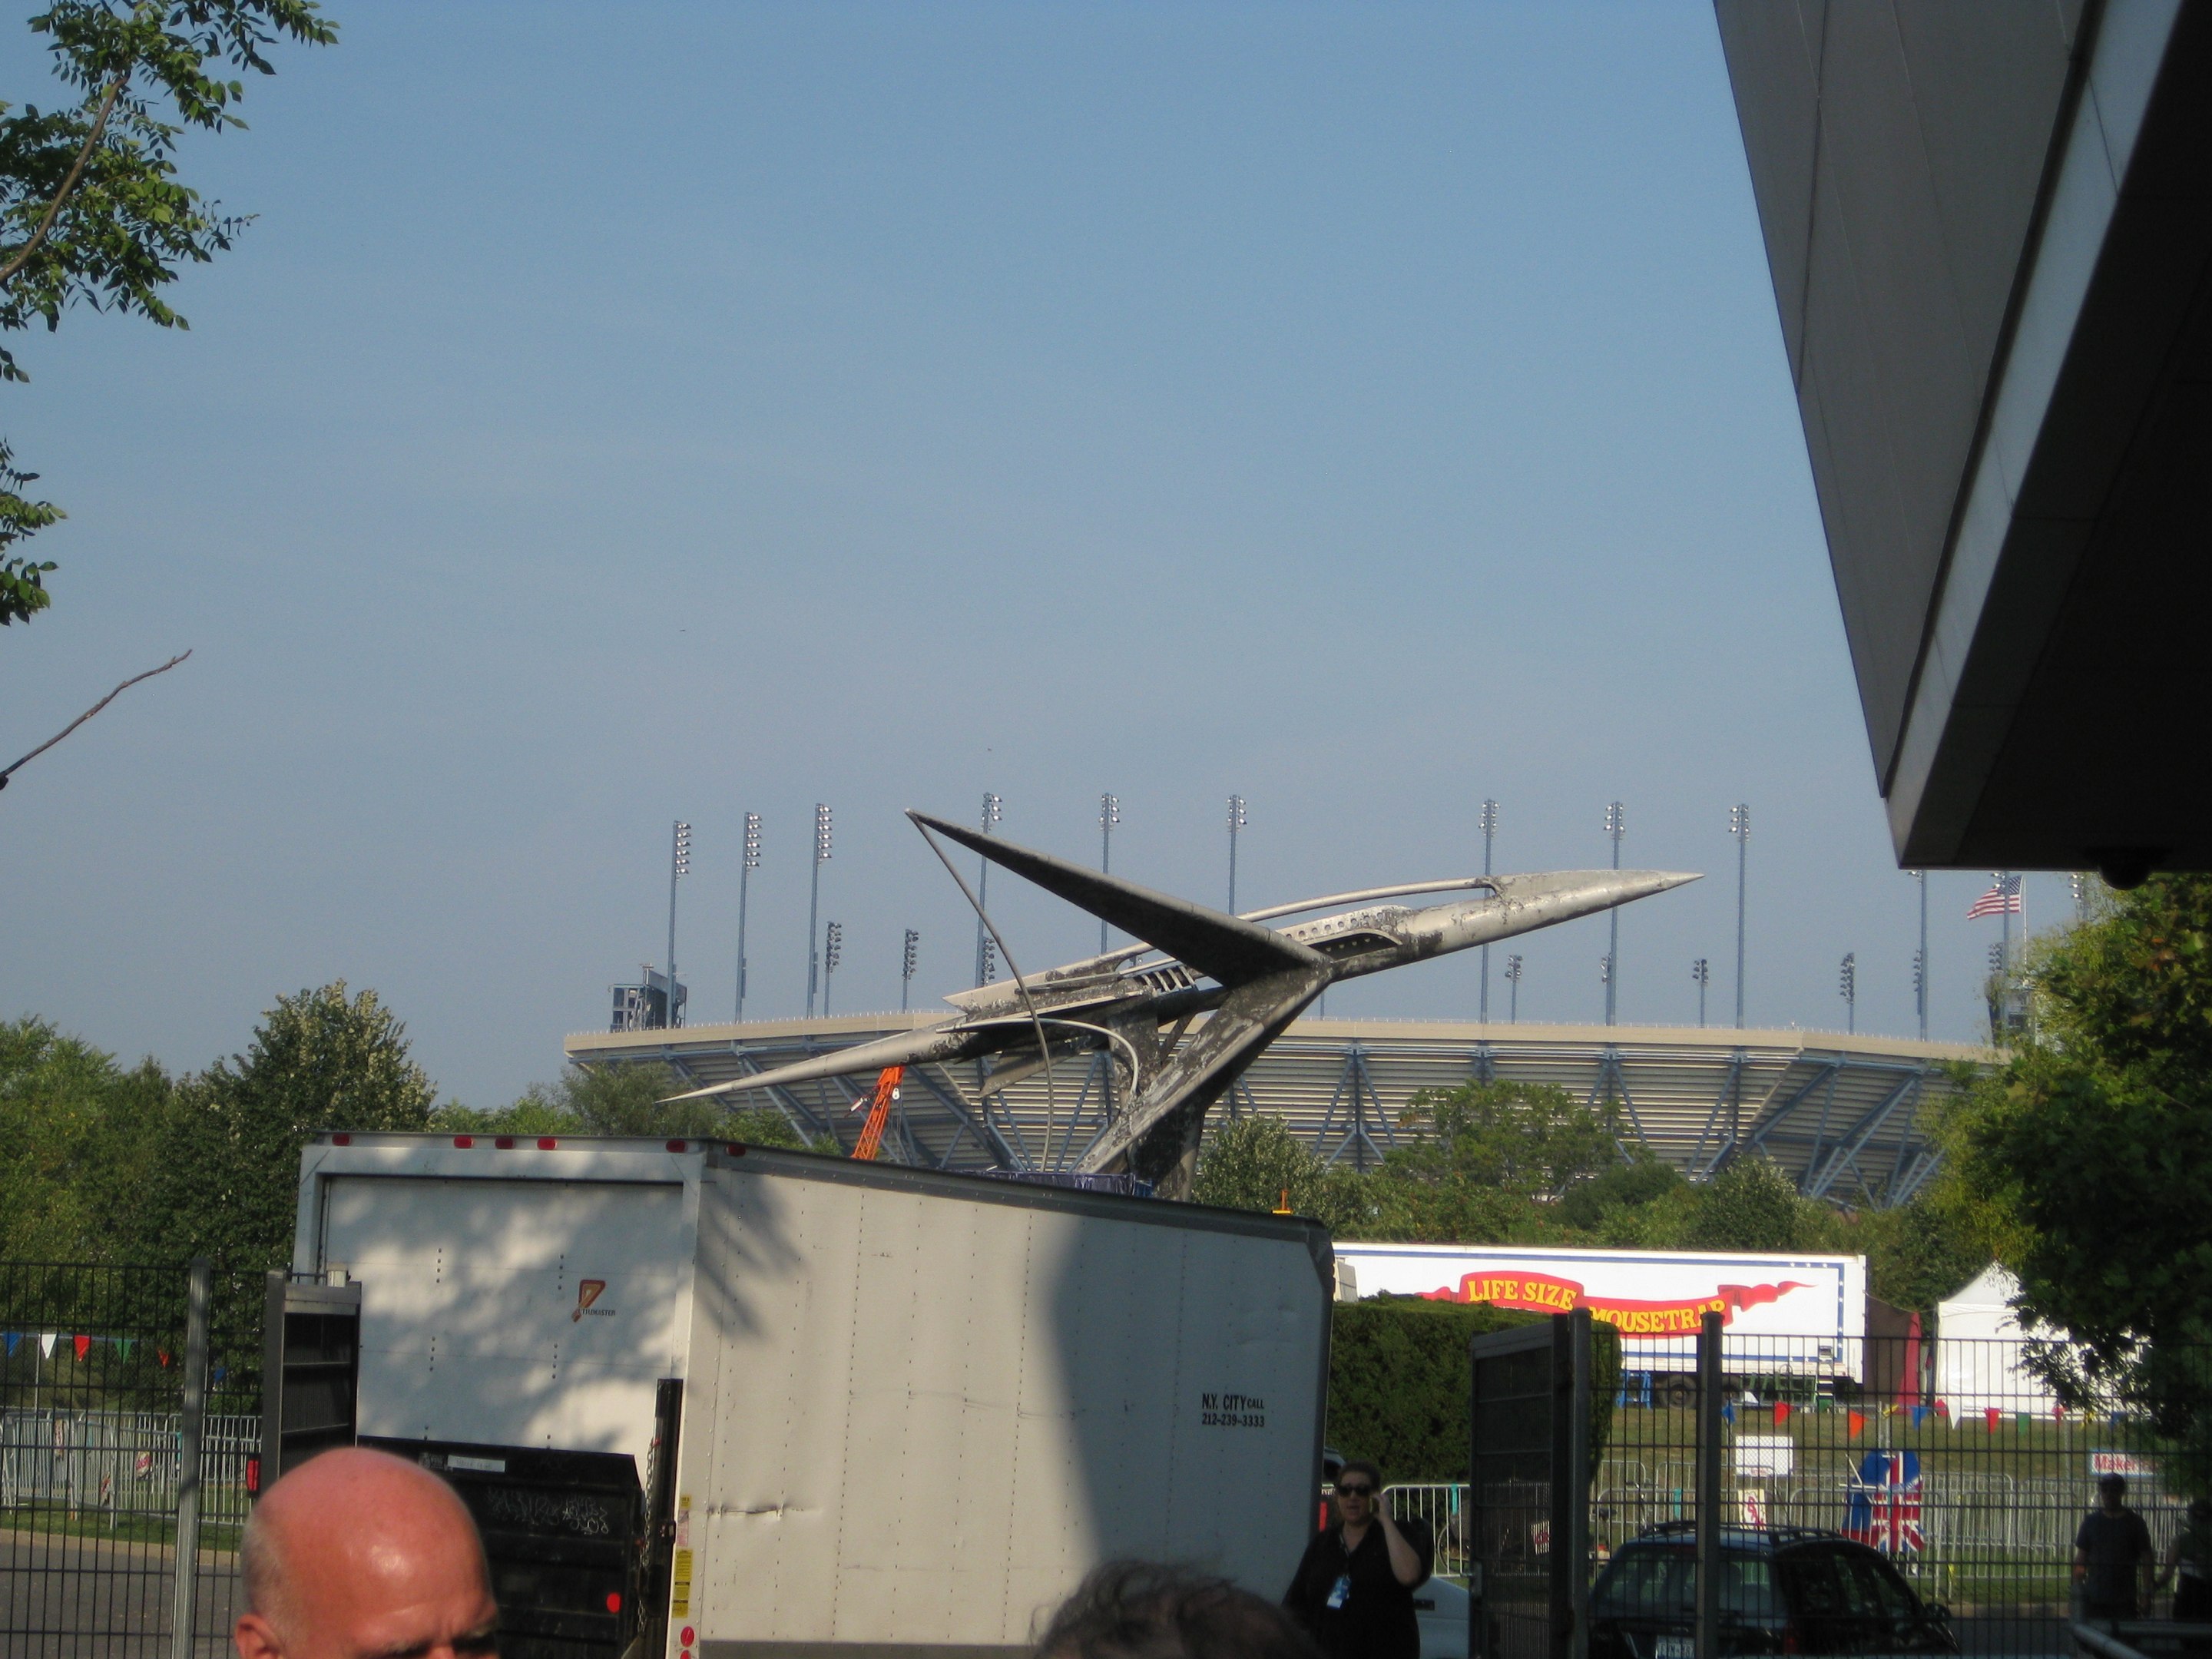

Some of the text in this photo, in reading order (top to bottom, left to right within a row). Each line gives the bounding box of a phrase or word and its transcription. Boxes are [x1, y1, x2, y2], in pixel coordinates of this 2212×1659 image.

[1468, 1279, 1578, 1311] LIFE SIZE
[1223, 1394, 1247, 1411] CITY
[1247, 1398, 1265, 1409] CALL
[1201, 1412, 1265, 1427] 212-239-3333
